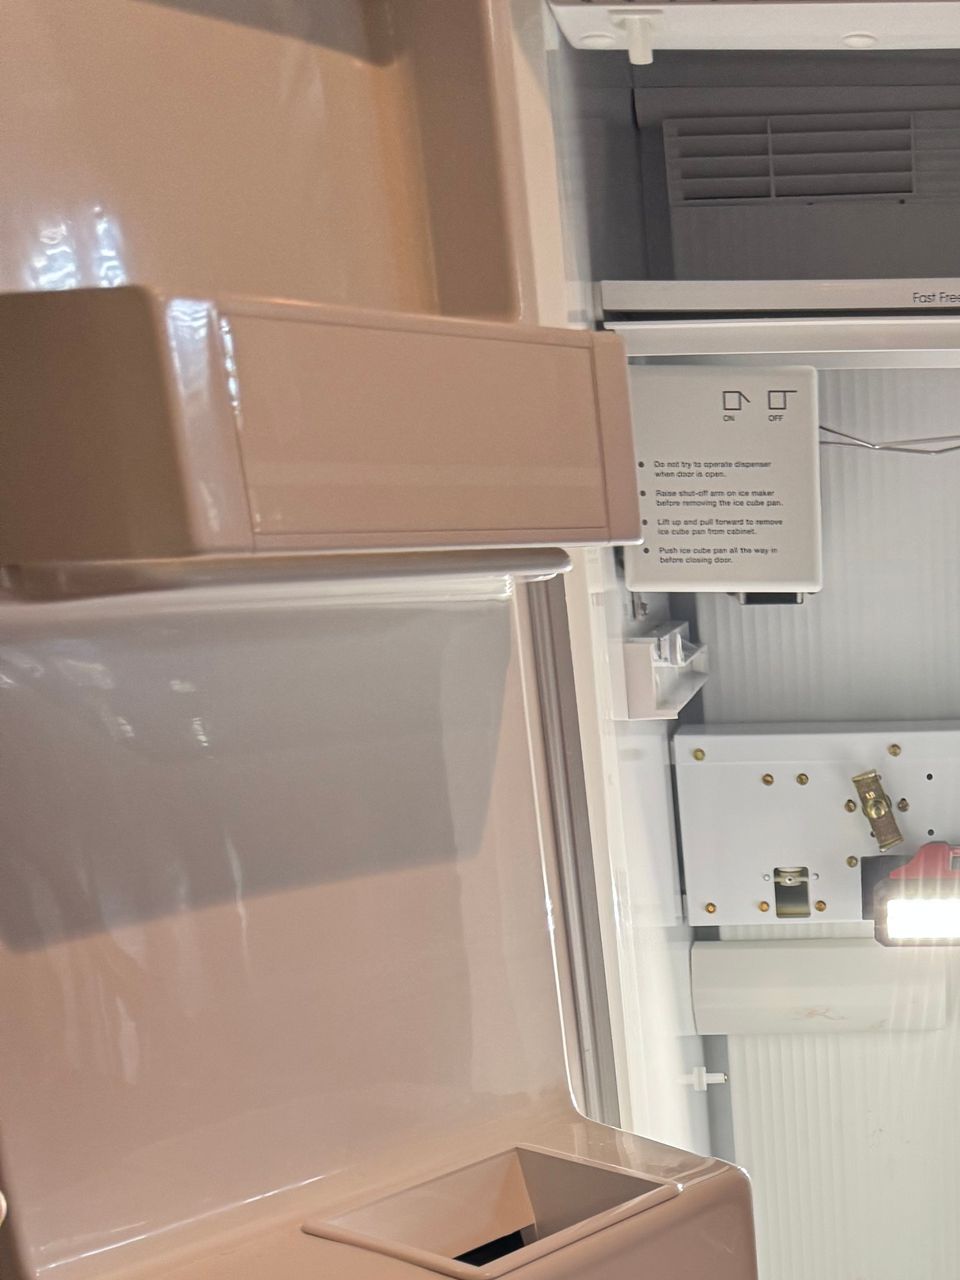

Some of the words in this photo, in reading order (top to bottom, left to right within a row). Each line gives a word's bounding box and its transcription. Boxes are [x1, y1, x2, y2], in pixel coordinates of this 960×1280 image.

[912, 292, 937, 303] Fast
[767, 414, 784, 422] OFF
[653, 460, 665, 468] Do
[667, 460, 680, 468] not
[681, 460, 692, 469] try
[694, 460, 702, 468] to
[703, 461, 733, 469] operate
[734, 460, 771, 469] dispenser
[682, 500, 717, 508] removing
[766, 500, 784, 508] pan.
[657, 518, 670, 526] Lift
[672, 518, 682, 526] up
[683, 518, 698, 526] and
[699, 518, 714, 527] pull
[715, 518, 744, 526] forward
[746, 518, 754, 526] to
[658, 546, 678, 554] Push
[693, 546, 711, 554] cube
[713, 547, 728, 555] pan
[729, 546, 738, 554] all
[740, 546, 752, 554] the
[754, 547, 769, 555] way
[770, 546, 778, 554] in
[685, 557, 712, 565] closing
